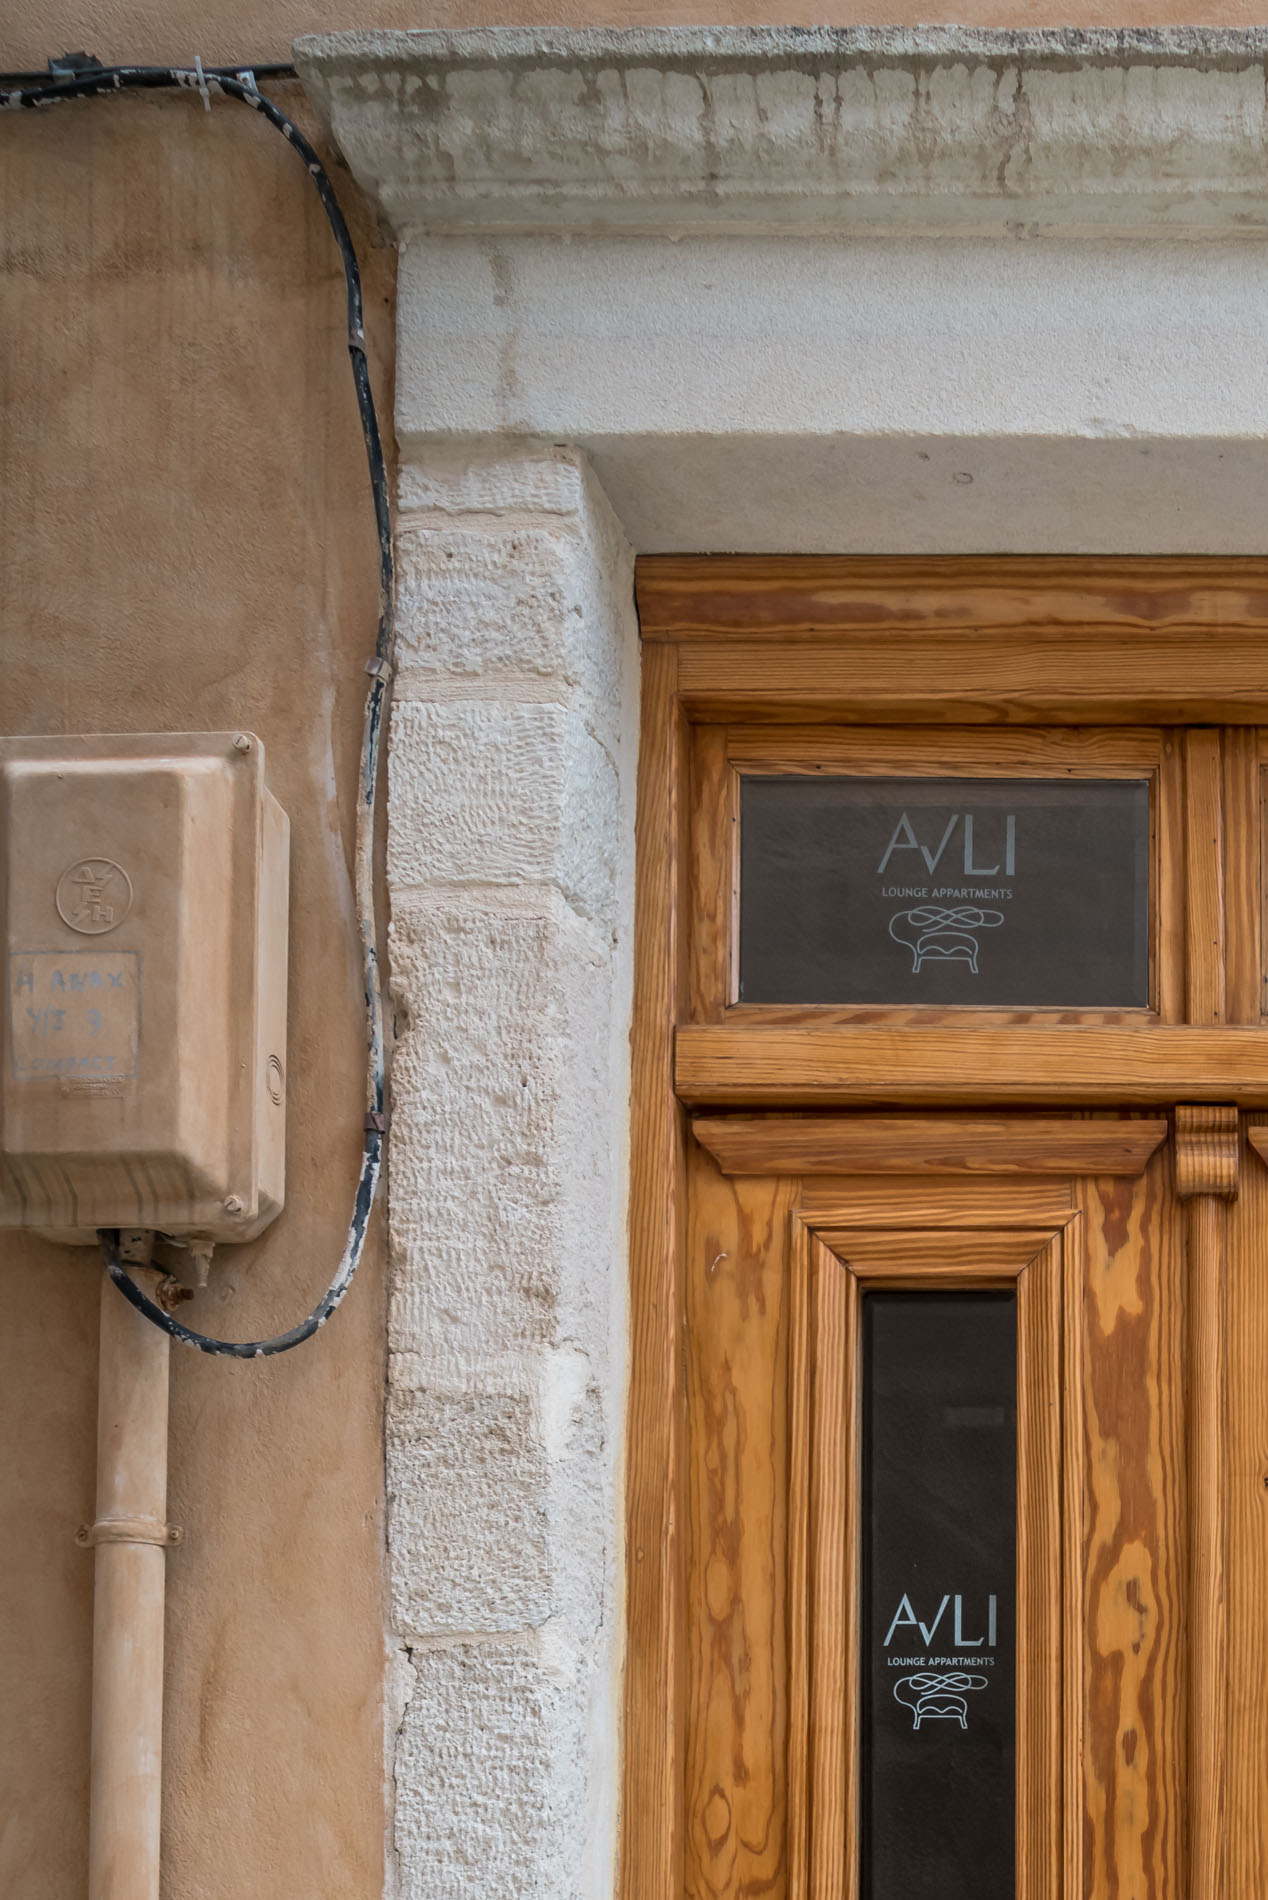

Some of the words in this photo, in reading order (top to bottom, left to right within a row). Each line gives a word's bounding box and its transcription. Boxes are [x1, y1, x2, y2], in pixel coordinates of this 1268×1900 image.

[875, 810, 1016, 876] AVLI
[882, 887, 929, 898] LOUNGE
[931, 887, 1014, 899] APPARTMENTS
[882, 1592, 997, 1648] AVLI
[887, 1657, 926, 1667] LOUNGE
[928, 1657, 995, 1667] APPARTMENTS
